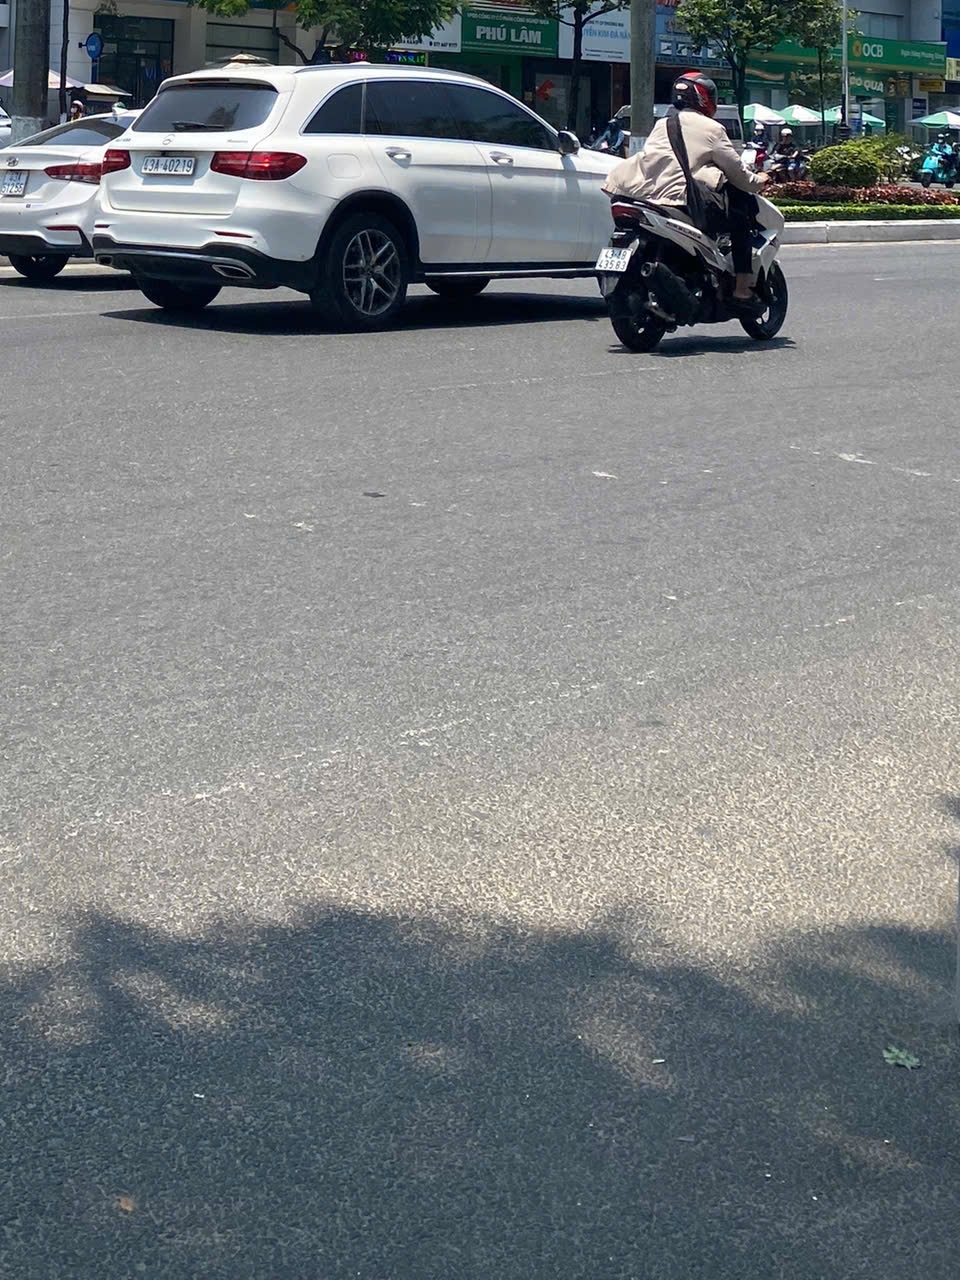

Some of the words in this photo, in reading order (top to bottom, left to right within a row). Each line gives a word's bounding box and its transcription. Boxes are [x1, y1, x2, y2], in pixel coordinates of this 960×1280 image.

[476, 24, 506, 41] PHÚ
[511, 26, 541, 44] LÂM
[863, 43, 883, 57] OCB
